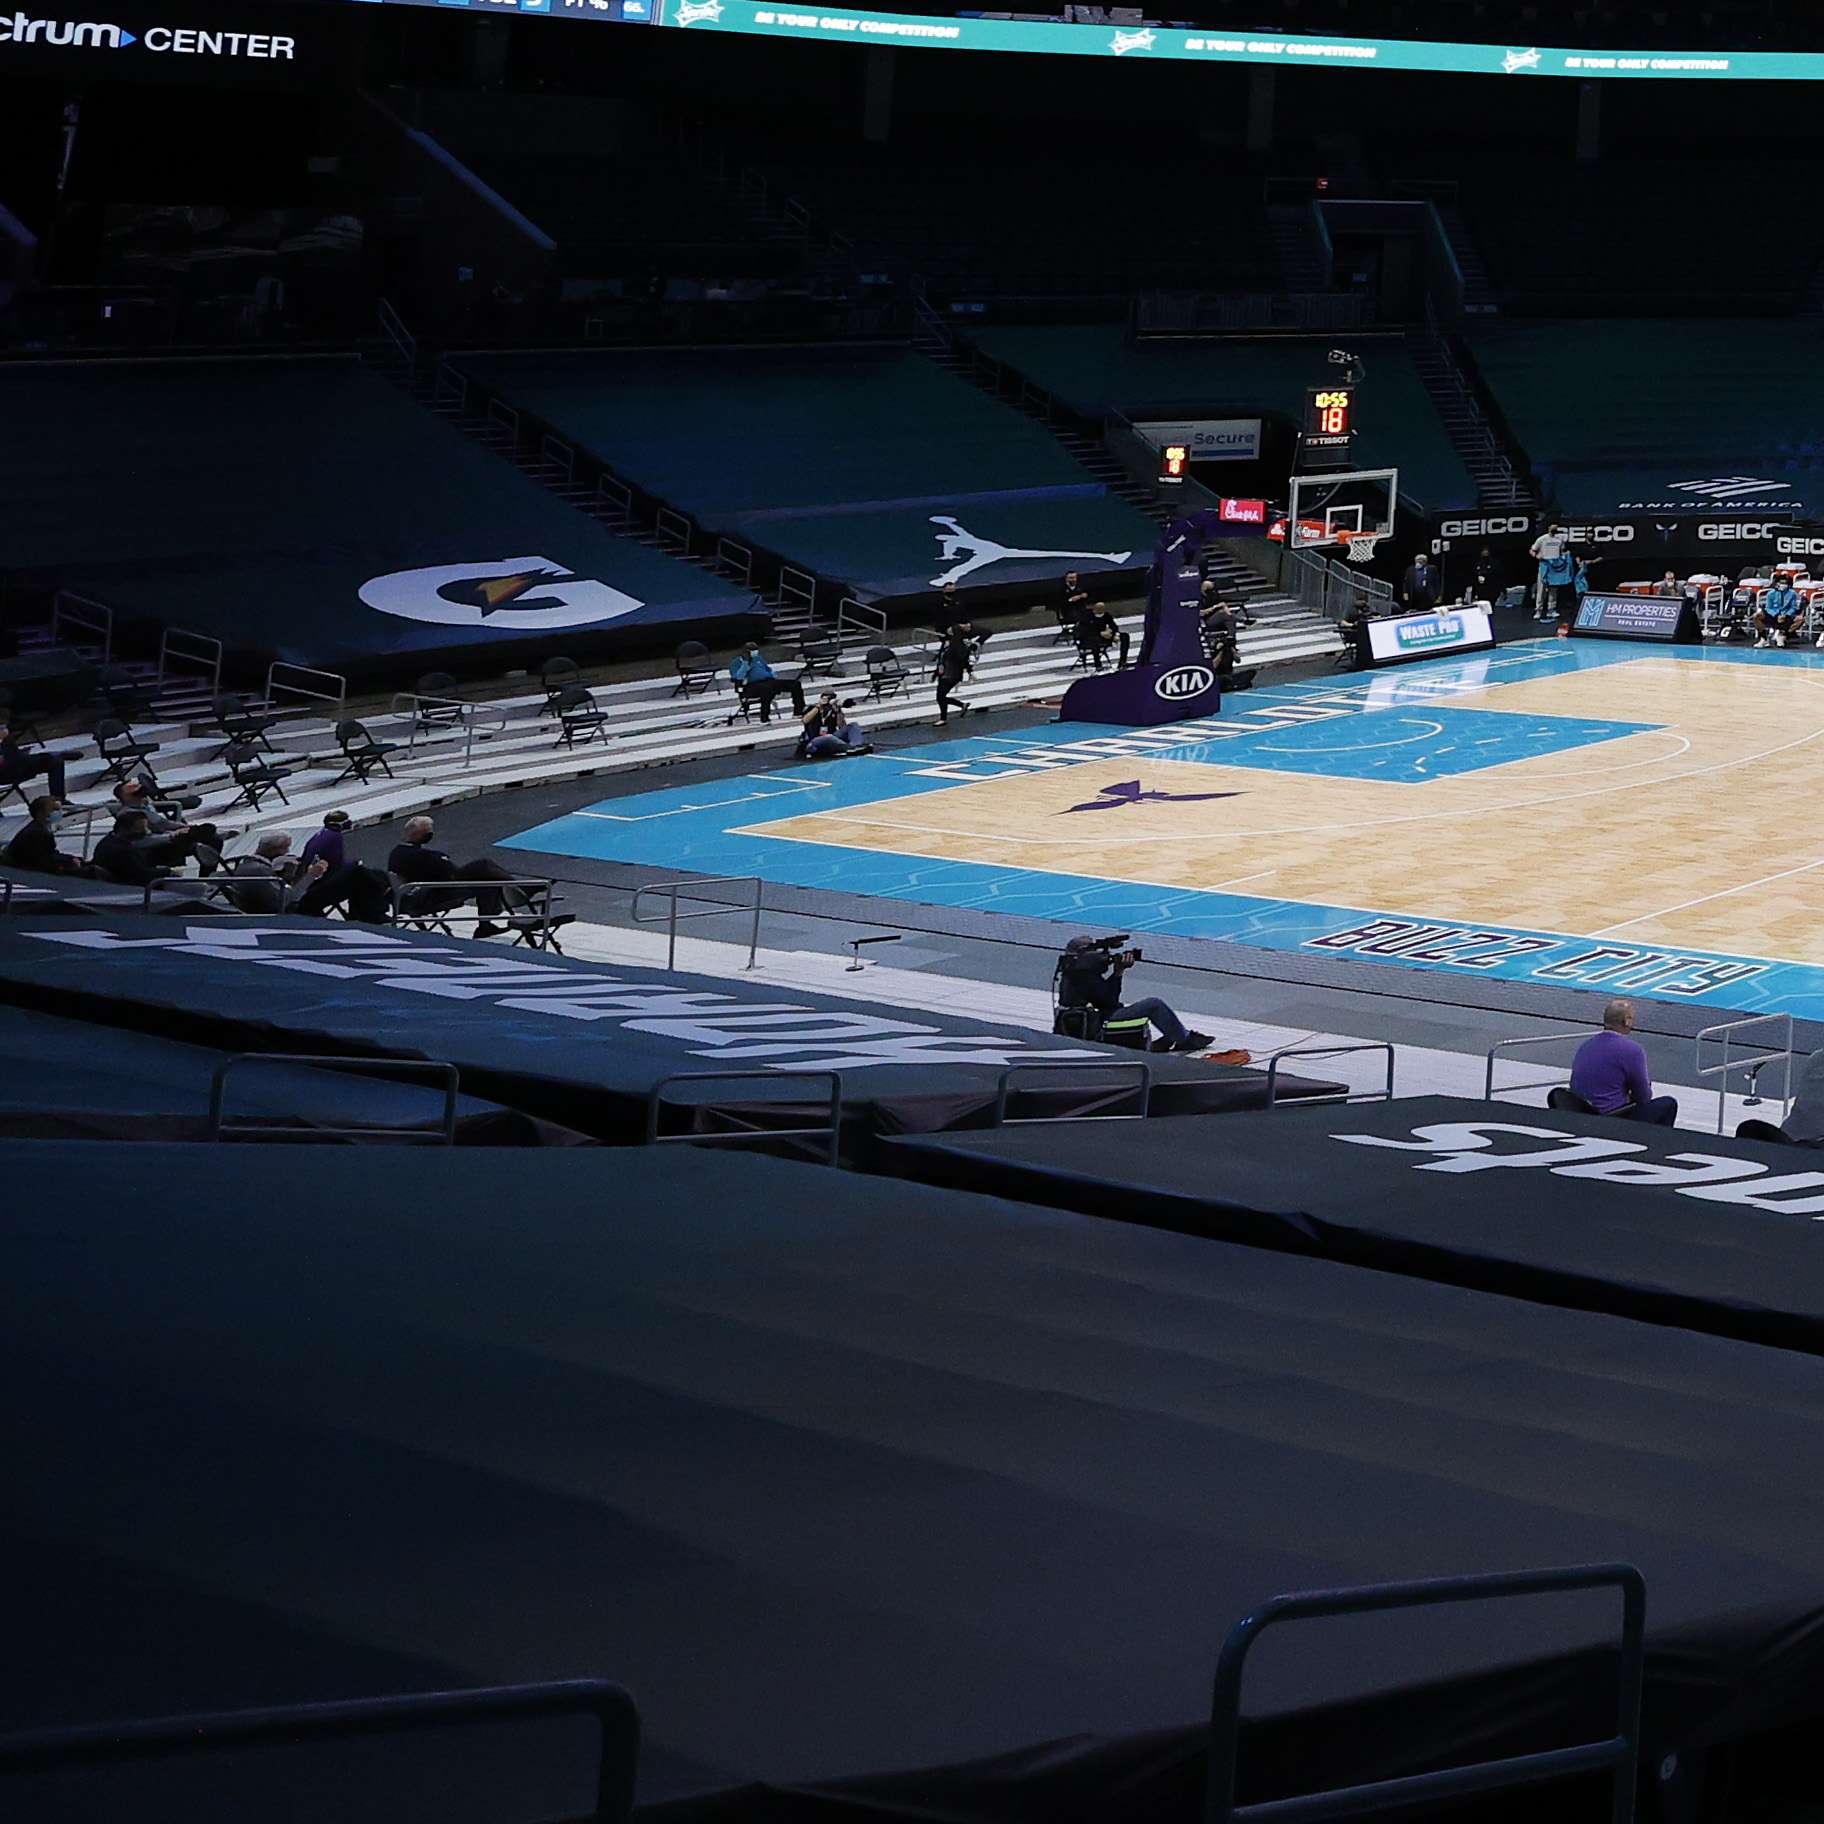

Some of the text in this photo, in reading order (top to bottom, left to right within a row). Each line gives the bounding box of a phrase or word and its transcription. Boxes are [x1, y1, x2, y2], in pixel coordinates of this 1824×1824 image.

[144, 27, 294, 59] CENTER
[1321, 408, 1343, 433] 18
[1194, 432, 1255, 445] Secure
[1441, 517, 1529, 536] GEICO
[1621, 604, 1677, 618] PROPERTIES
[1165, 671, 1205, 692] KIA
[1302, 917, 1769, 997] BUZZ CITY
[19, 927, 1112, 1071] HORNETS
